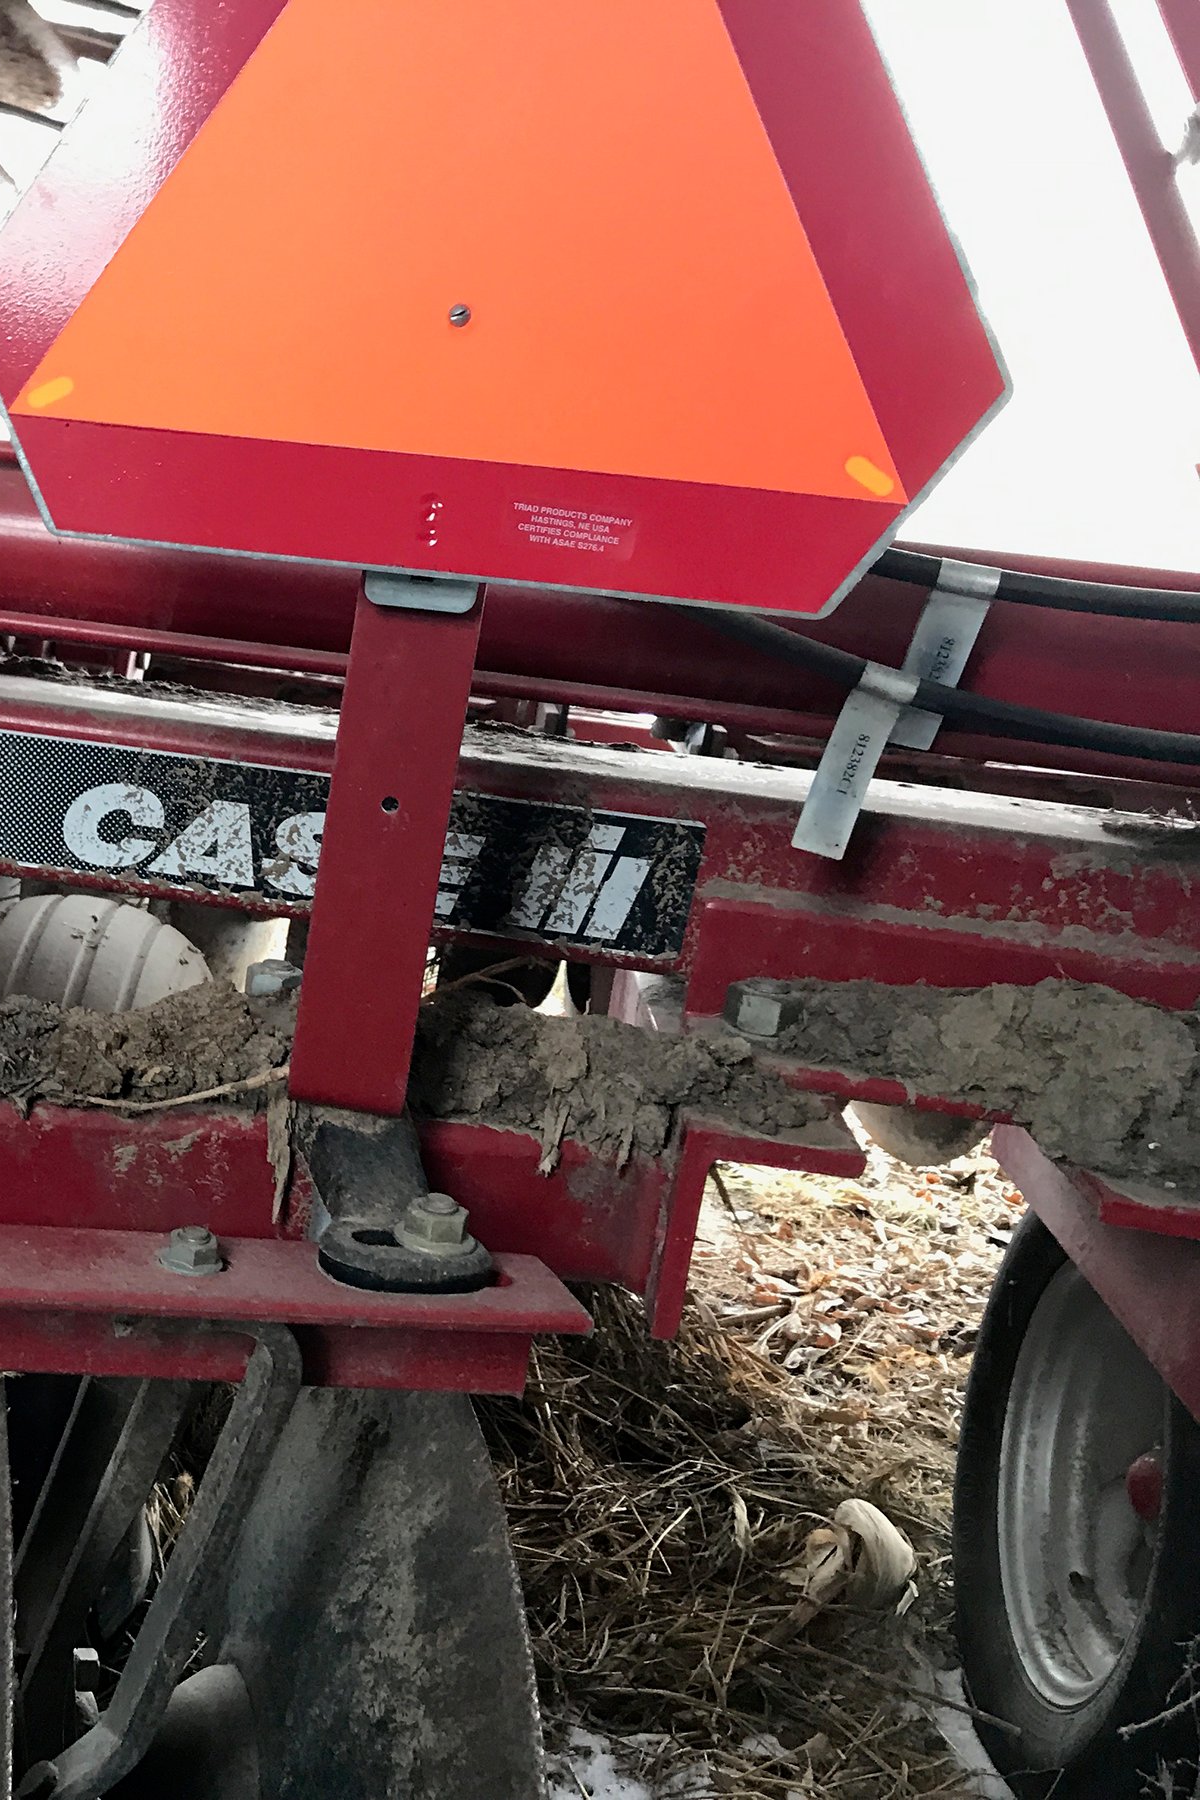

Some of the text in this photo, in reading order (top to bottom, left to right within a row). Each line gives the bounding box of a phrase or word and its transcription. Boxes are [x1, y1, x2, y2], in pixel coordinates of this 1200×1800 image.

[513, 502, 633, 527] TRIAD PRODUCTS COMPANY
[531, 515, 610, 533] HASTINGS, NE USA
[517, 523, 620, 545] CERTIFIES COMPLIANCE
[529, 534, 604, 553] WITH ASAE S276.4
